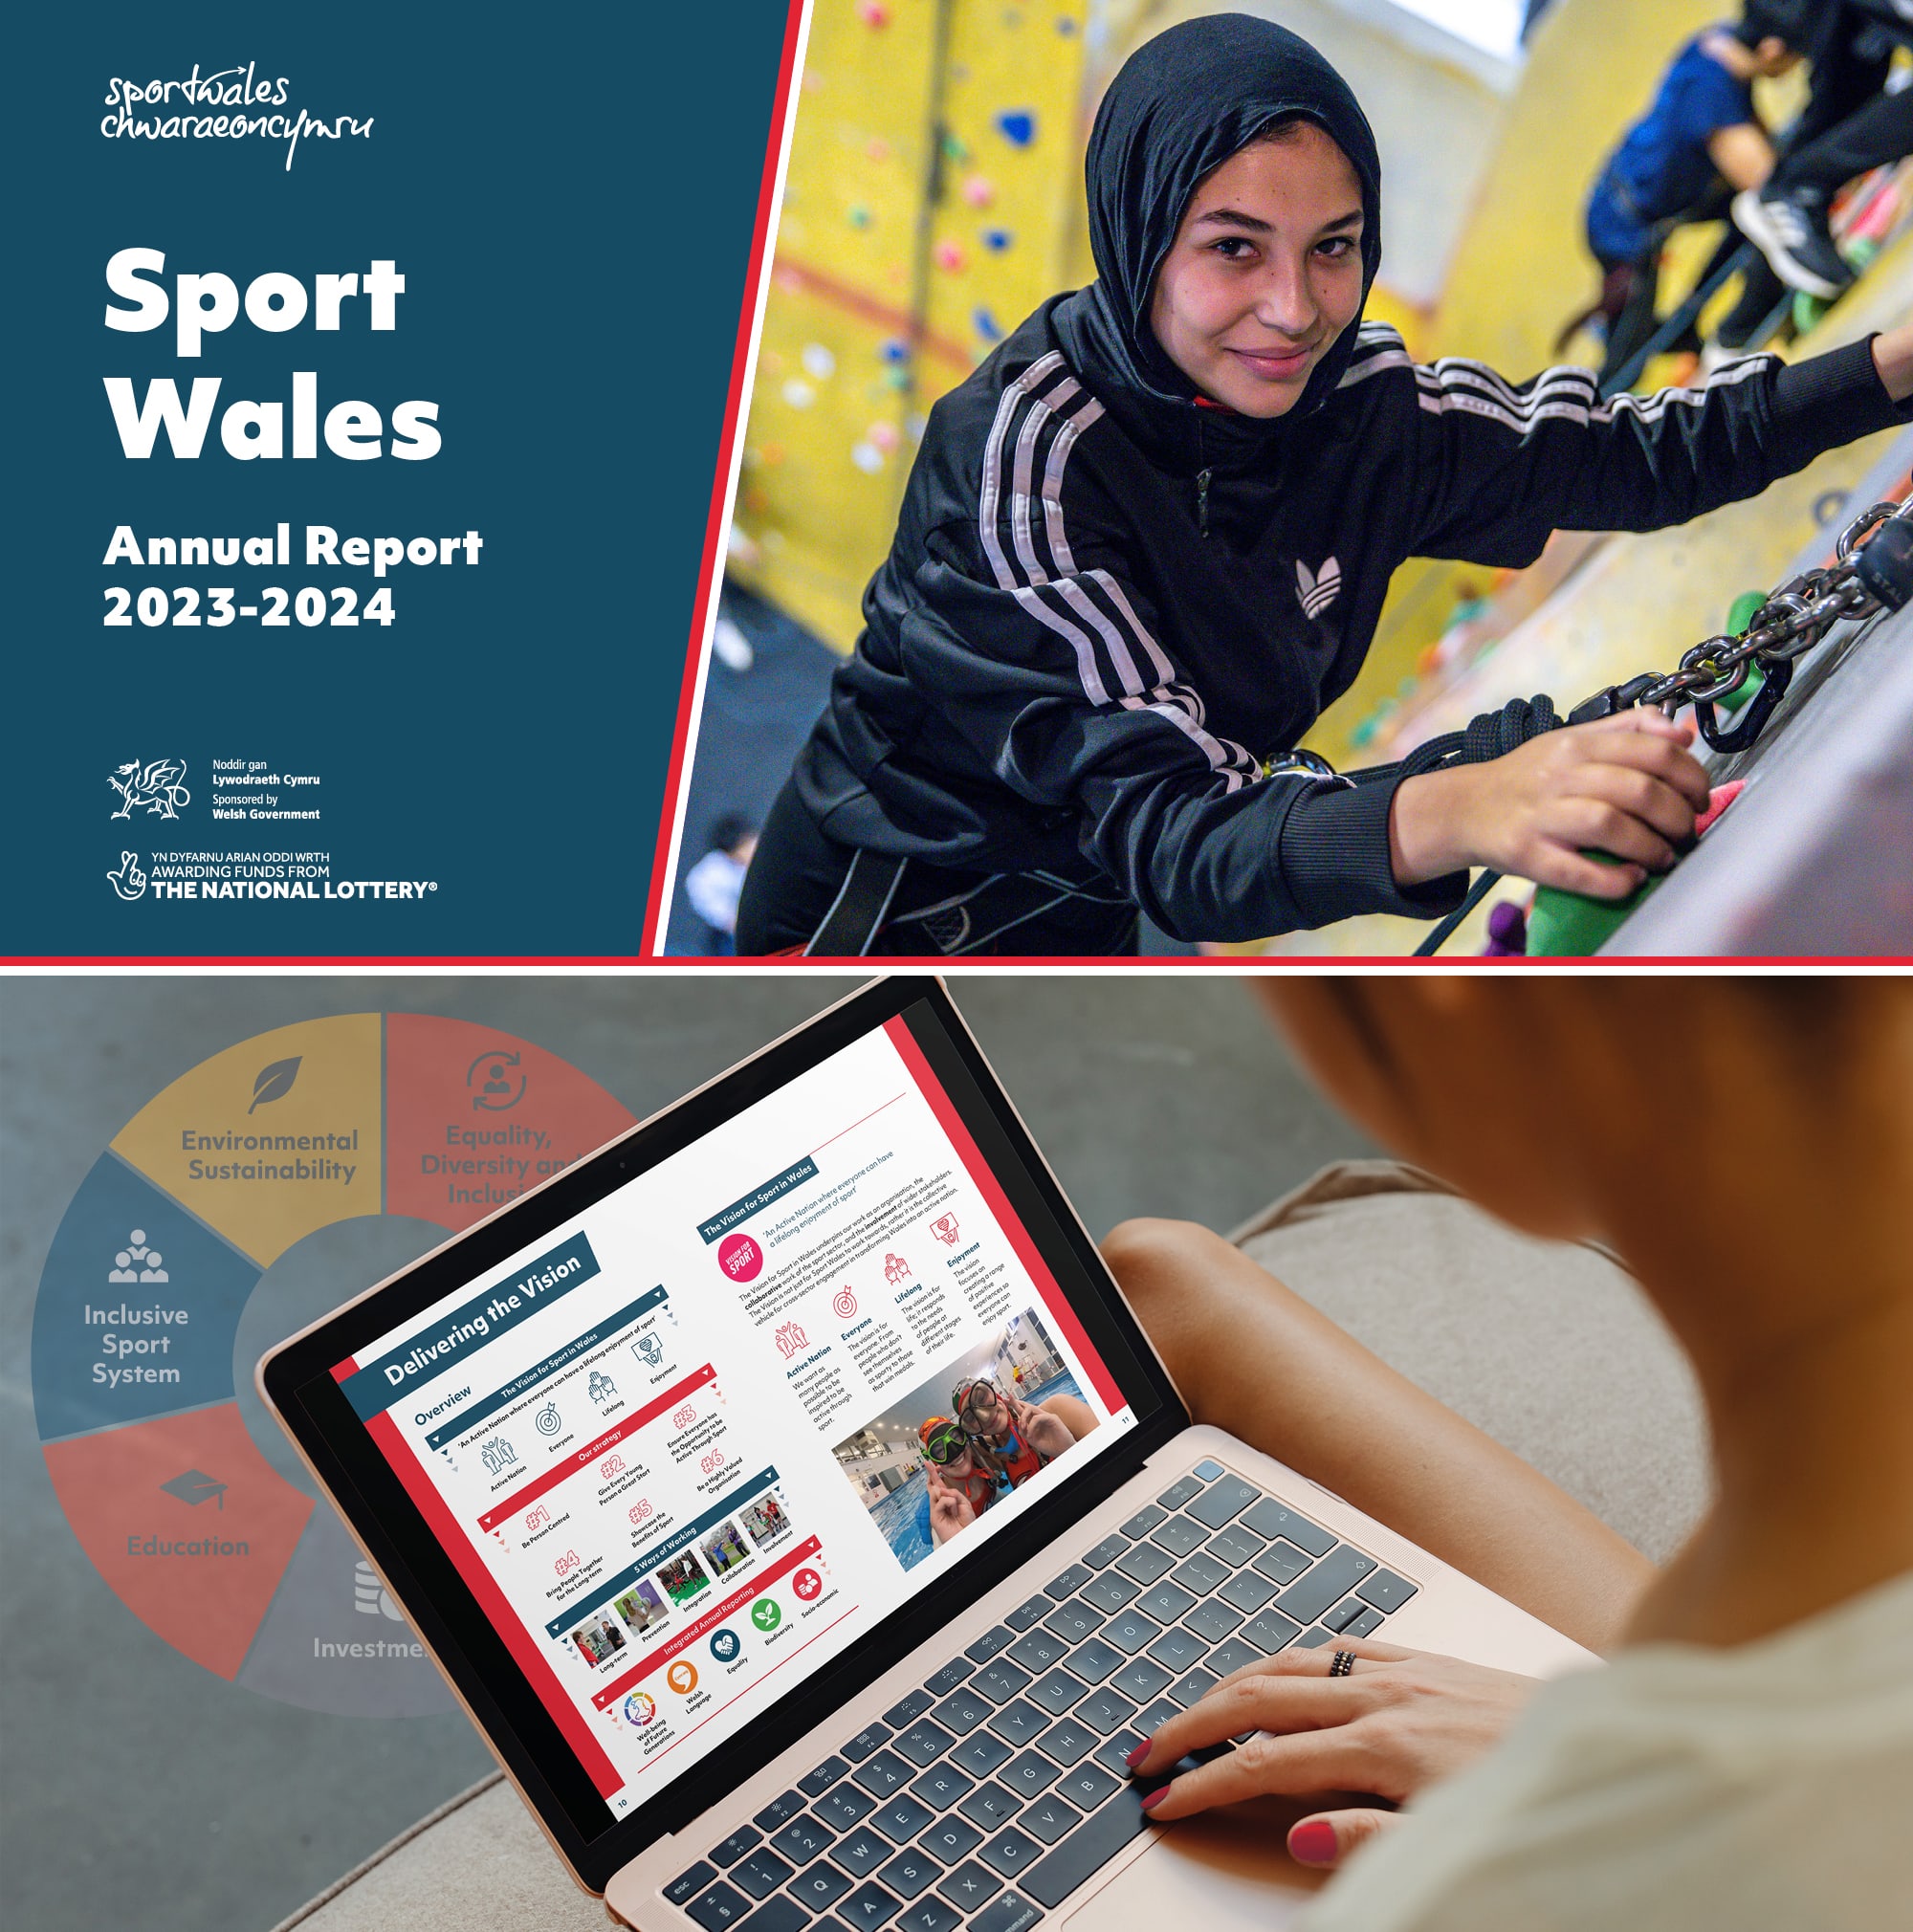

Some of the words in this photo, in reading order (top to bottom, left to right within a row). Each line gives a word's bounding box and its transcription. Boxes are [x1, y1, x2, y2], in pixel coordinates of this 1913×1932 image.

[704, 1224, 722, 1236] The
[719, 1208, 746, 1226] Vision
[745, 1199, 758, 1211] for
[758, 1185, 780, 1203] Sport
[778, 1180, 788, 1189] in
[786, 1165, 812, 1183] Wales
[775, 1216, 796, 1232] Active
[794, 1201, 819, 1218] Nation
[817, 1188, 838, 1203] where
[837, 1169, 867, 1191] everyone
[866, 1161, 878, 1172] can
[876, 1152, 893, 1164] have
[774, 1225, 801, 1244] lifelong
[799, 1203, 832, 1228] enjoyment
[832, 1197, 840, 1207] of
[725, 1248, 742, 1265] VISION
[740, 1240, 751, 1252] FOR
[729, 1246, 755, 1275] SPORT
[947, 1242, 980, 1267] Enjoyment
[894, 1284, 922, 1304] Lifelong
[384, 1315, 490, 1386] Delivering
[487, 1295, 521, 1322] the
[517, 1257, 582, 1298] Vision
[841, 1318, 872, 1341] Everyone
[500, 1387, 517, 1397] The
[515, 1372, 539, 1389] Vision
[538, 1365, 549, 1374] for
[548, 1351, 568, 1368] Sport
[574, 1333, 598, 1350] Wales
[649, 1364, 677, 1385] Enjoyment
[786, 1362, 809, 1379] Active
[807, 1346, 831, 1364] Nation
[415, 1386, 471, 1425] Overview
[602, 1400, 625, 1416] Lifelong
[672, 1403, 696, 1430] #3
[548, 1434, 574, 1453] Everyone
[667, 1435, 685, 1448] Ensure
[684, 1418, 708, 1437] Everyone
[707, 1413, 717, 1421] has
[671, 1448, 680, 1457] the
[679, 1428, 710, 1450] Opportunity
[579, 1450, 592, 1460] Our
[592, 1430, 622, 1453] strategy
[676, 1451, 693, 1463] Active
[691, 1436, 714, 1452] Through
[712, 1426, 727, 1438] Sport
[600, 1454, 626, 1480] #2
[700, 1448, 725, 1475] #6
[708, 1470, 725, 1483] Highly
[723, 1457, 743, 1472] Valued
[491, 1478, 509, 1492] Active
[507, 1465, 527, 1481] Nation
[598, 1485, 610, 1496] Give
[609, 1475, 626, 1488] Every
[624, 1463, 643, 1477] Young
[599, 1492, 618, 1506] Person
[621, 1478, 637, 1490] Great
[636, 1469, 650, 1481] Start
[708, 1470, 740, 1494] Organisation
[525, 1504, 551, 1531] #1
[628, 1498, 652, 1525] #5
[529, 1528, 549, 1544] Person
[547, 1512, 570, 1530] Centred
[630, 1519, 657, 1538] Showcase
[656, 1512, 666, 1521] the
[631, 1531, 654, 1548] Benefits
[658, 1517, 673, 1529] Sport
[639, 1553, 660, 1569] Ways
[659, 1546, 668, 1555] of
[666, 1527, 697, 1549] Working
[762, 1530, 793, 1554] Involvement
[555, 1549, 581, 1577] #4
[721, 1559, 756, 1585] Collaboration
[545, 1586, 562, 1598] Bring
[561, 1573, 580, 1588] People
[578, 1556, 603, 1574] Together
[565, 1587, 575, 1595] the
[574, 1568, 603, 1589] Long-term
[683, 1591, 712, 1613] Integration
[801, 1589, 839, 1618] Socio-economic
[642, 1621, 670, 1642] Prevention
[664, 1625, 699, 1655] Integrated
[699, 1609, 723, 1630] Annual
[721, 1588, 755, 1613] Reporting
[764, 1623, 794, 1646] Biodiversity
[599, 1652, 627, 1674] Long-term
[726, 1657, 748, 1675] Equality
[685, 1694, 712, 1715] Language
[686, 1691, 704, 1704] Welsh
[636, 1719, 667, 1742] Well-being
[644, 1738, 650, 1746] of
[649, 1727, 668, 1742] Future
[644, 1730, 675, 1755] Generations
[974, 1747, 986, 1758] T
[935, 1780, 949, 1791] R
[618, 1799, 627, 1808] 10
[895, 1812, 909, 1824] E
[852, 1843, 869, 1858] W
[673, 1880, 690, 1895] esc
[813, 1879, 829, 1891] Q
